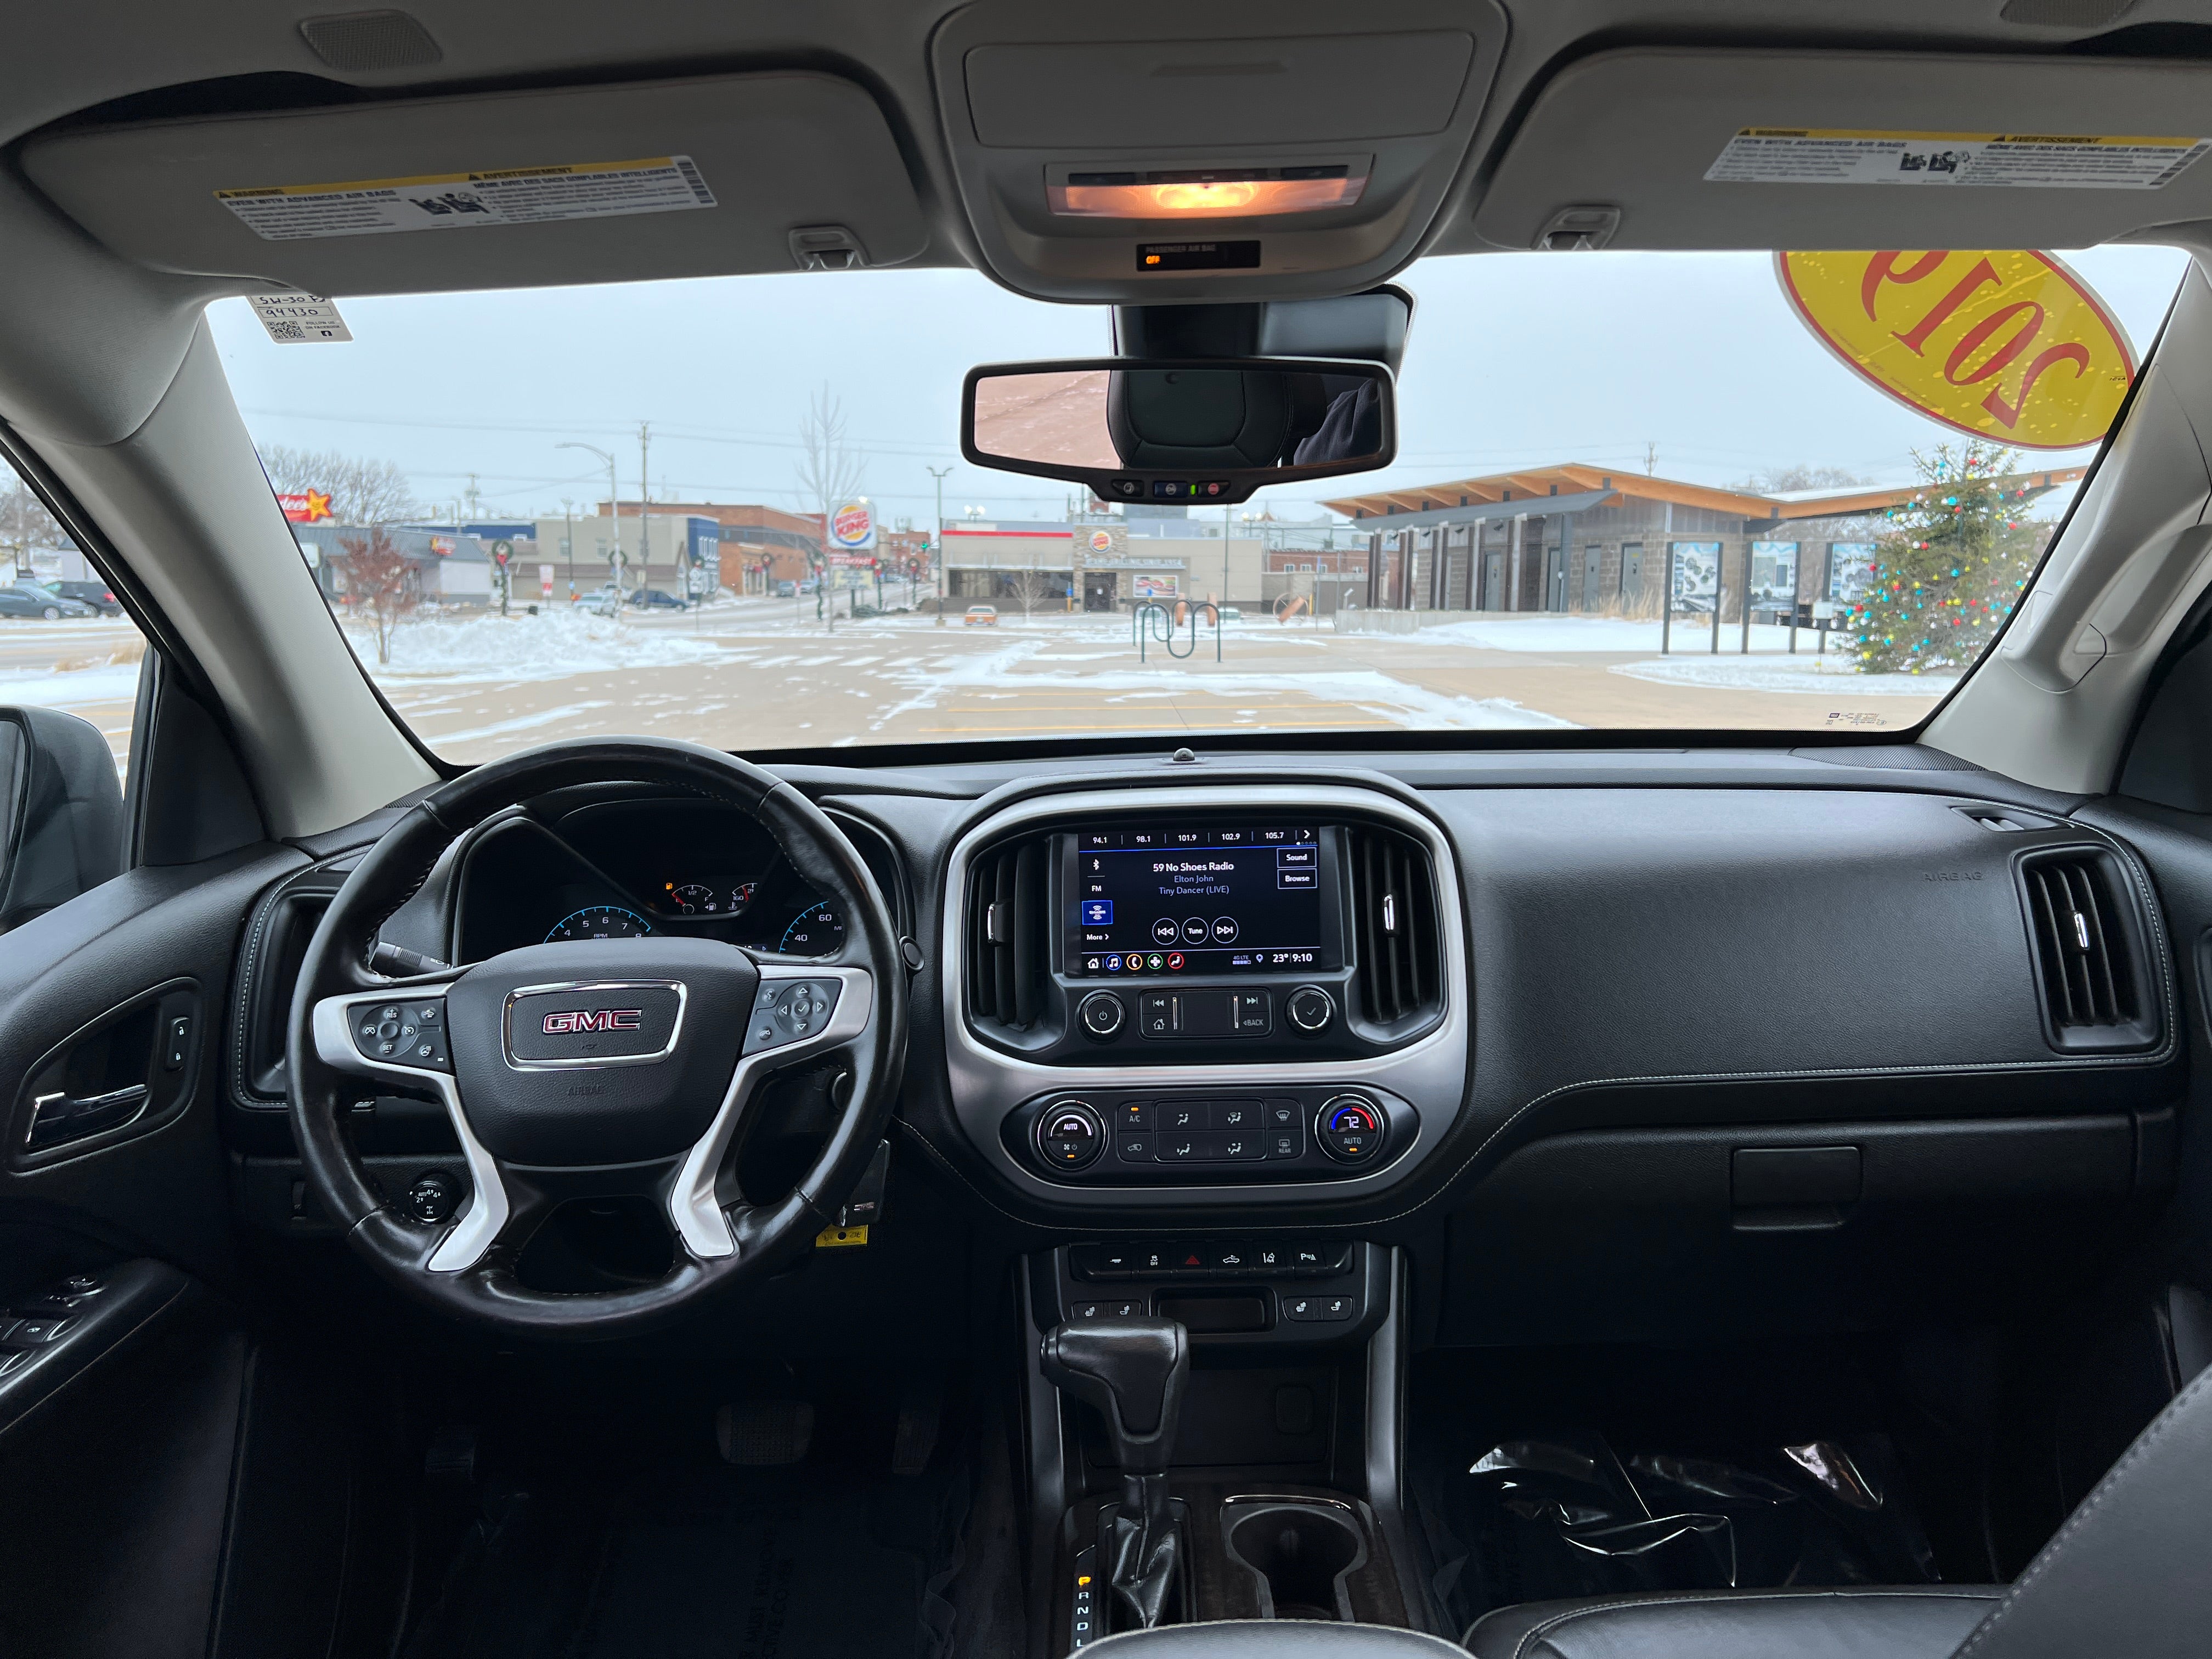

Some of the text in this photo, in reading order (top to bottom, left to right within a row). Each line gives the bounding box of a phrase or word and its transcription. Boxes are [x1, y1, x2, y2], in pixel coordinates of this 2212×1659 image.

[266, 308, 318, 317] 94430
[837, 519, 870, 537] KING
[1153, 862, 1234, 872] 59 No Shoes Radio
[1195, 874, 1214, 884] John
[1158, 885, 1229, 896] Tiny Dancer (LIVE)
[1292, 953, 1313, 962] 9:10
[543, 1009, 642, 1034] GMC
[1247, 1018, 1263, 1027] BACK
[1344, 1116, 1359, 1128] 72
[1079, 1576, 1091, 1585] P
[1077, 1606, 1089, 1615] N
